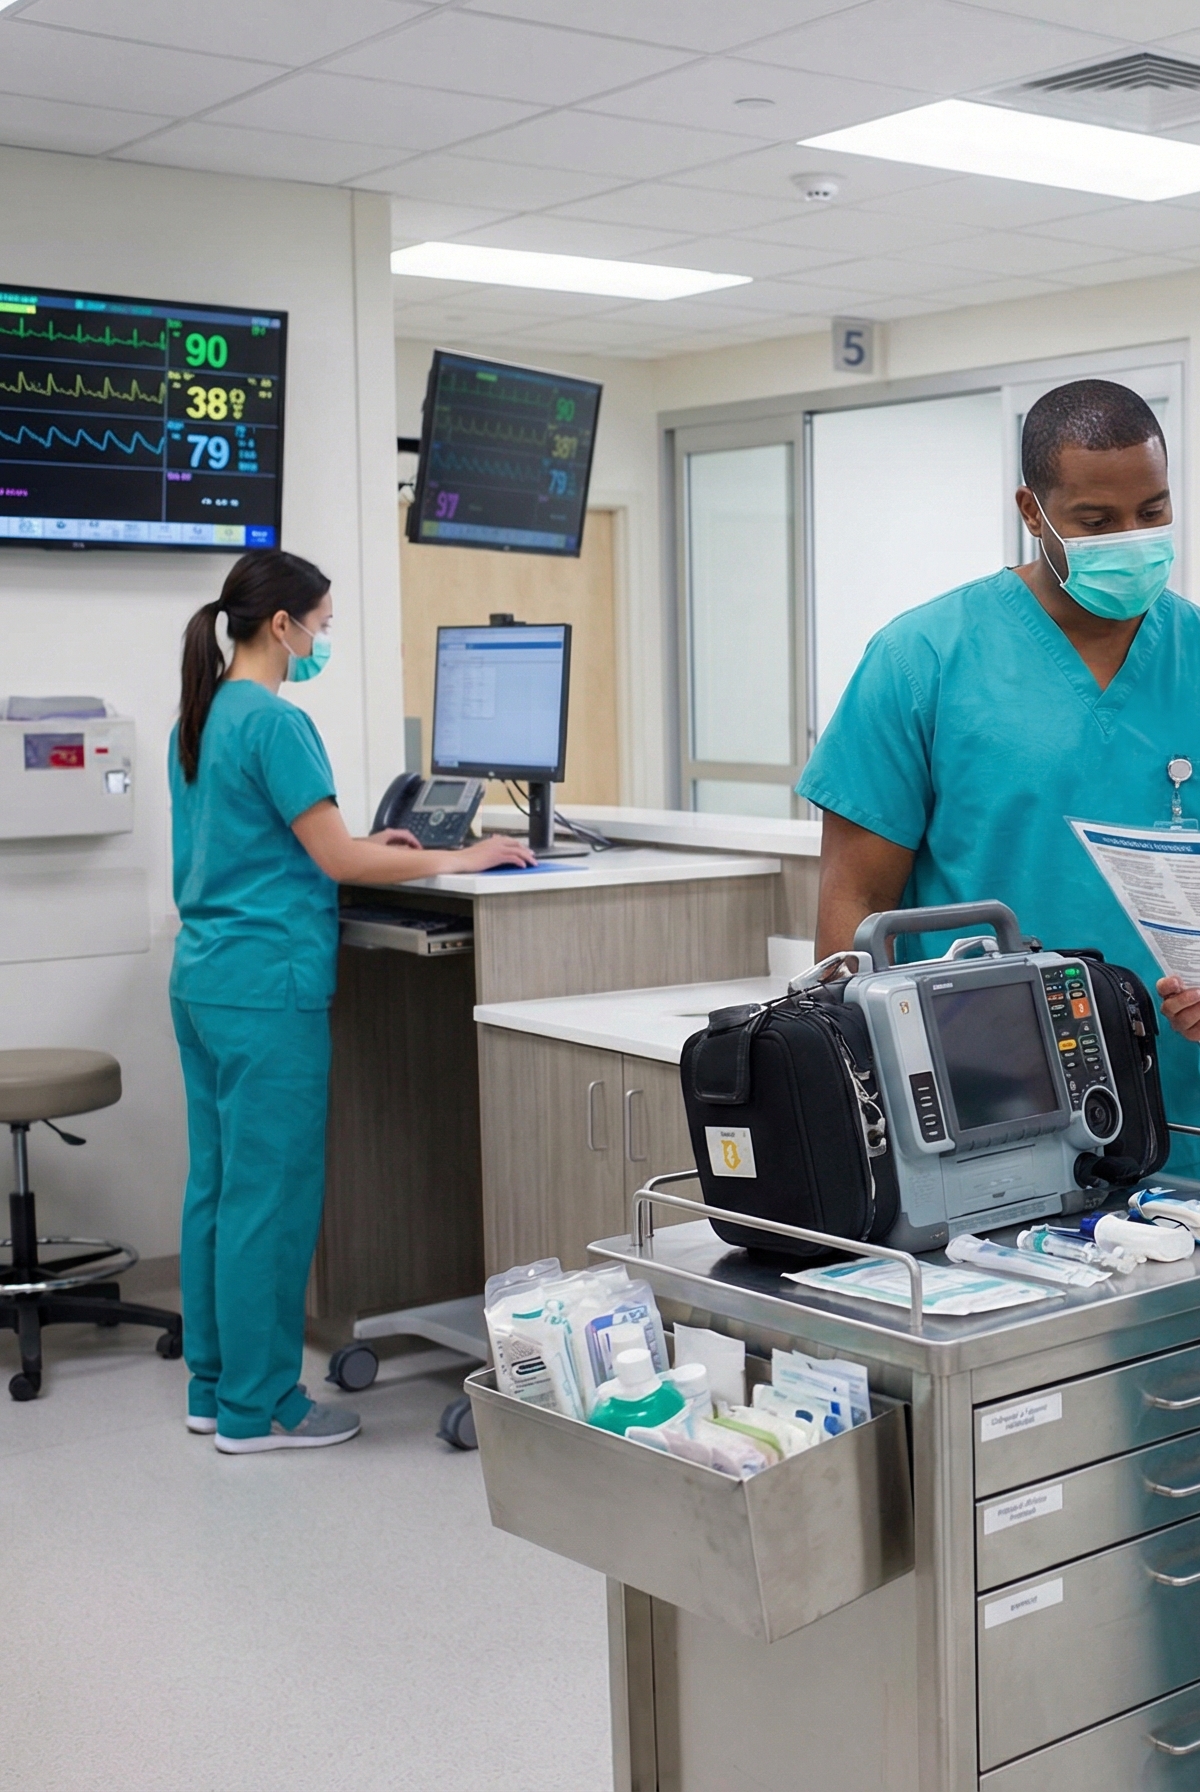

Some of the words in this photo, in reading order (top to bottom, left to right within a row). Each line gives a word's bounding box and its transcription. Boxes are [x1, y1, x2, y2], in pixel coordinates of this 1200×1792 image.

[185, 332, 228, 369] 90
[843, 330, 866, 367] 5
[185, 433, 230, 470] 79
[435, 490, 460, 519] 97
